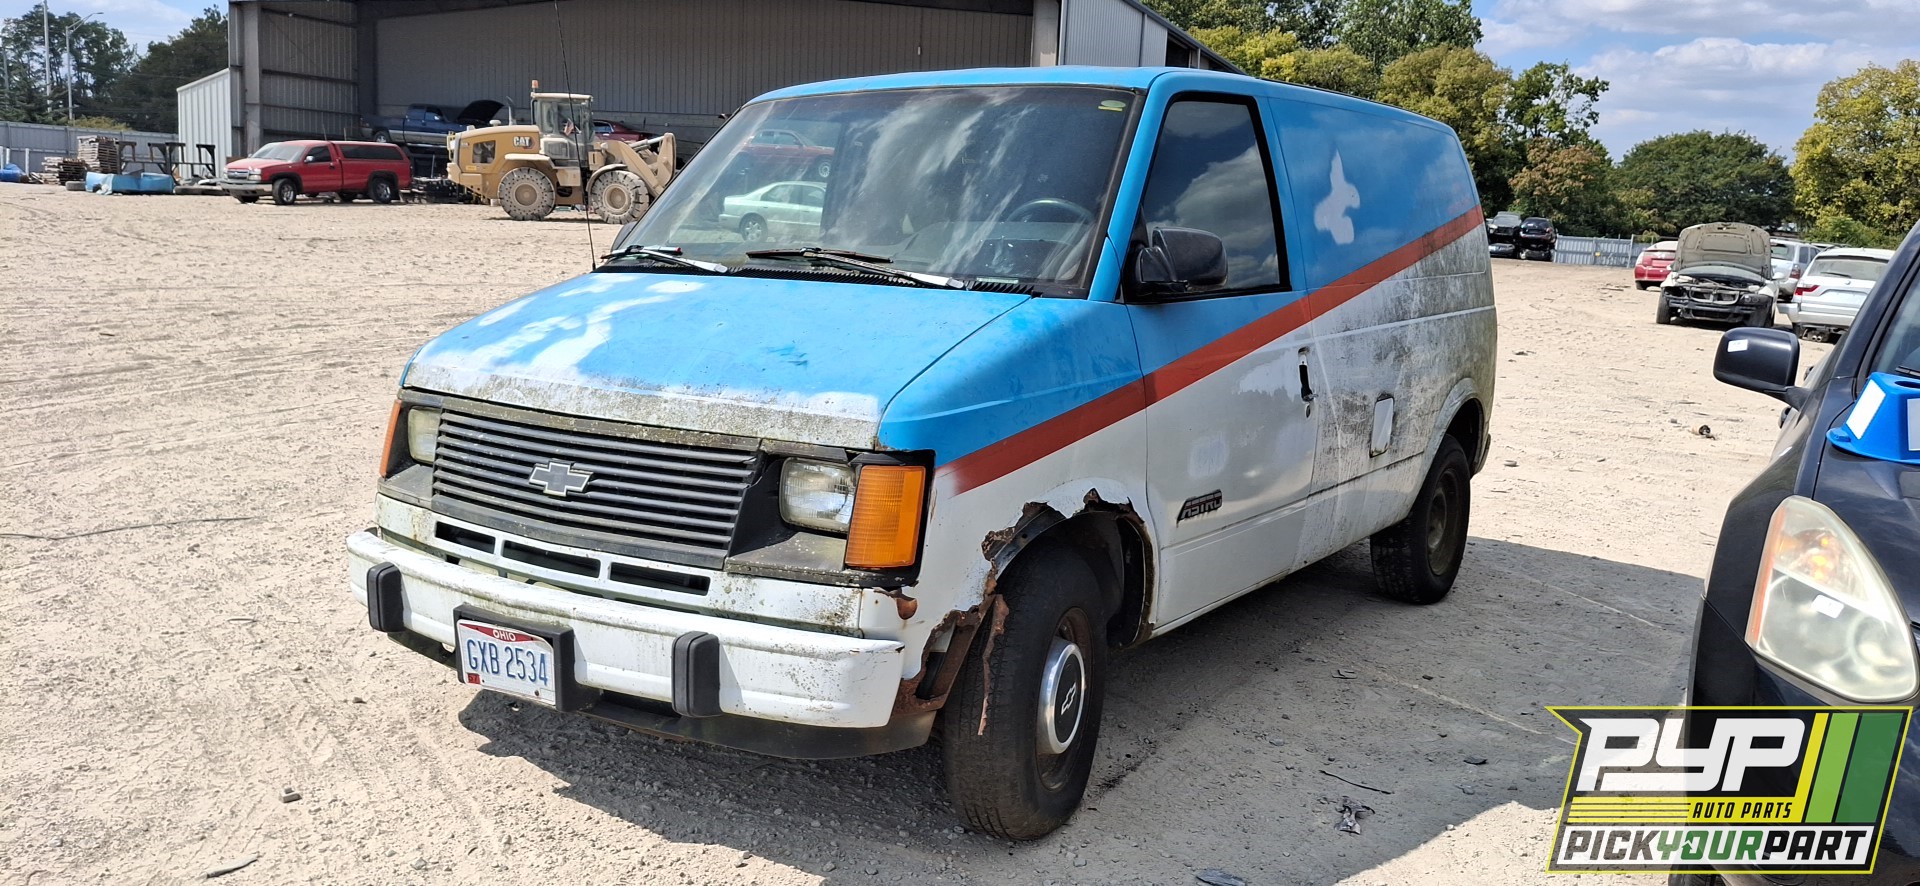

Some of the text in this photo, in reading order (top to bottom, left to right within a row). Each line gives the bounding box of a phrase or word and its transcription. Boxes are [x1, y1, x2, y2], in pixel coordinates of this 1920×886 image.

[513, 136, 531, 147] CAT
[1178, 490, 1222, 520] ASTRO
[493, 630, 516, 641] OHIO
[467, 639, 548, 685] GXB 2534
